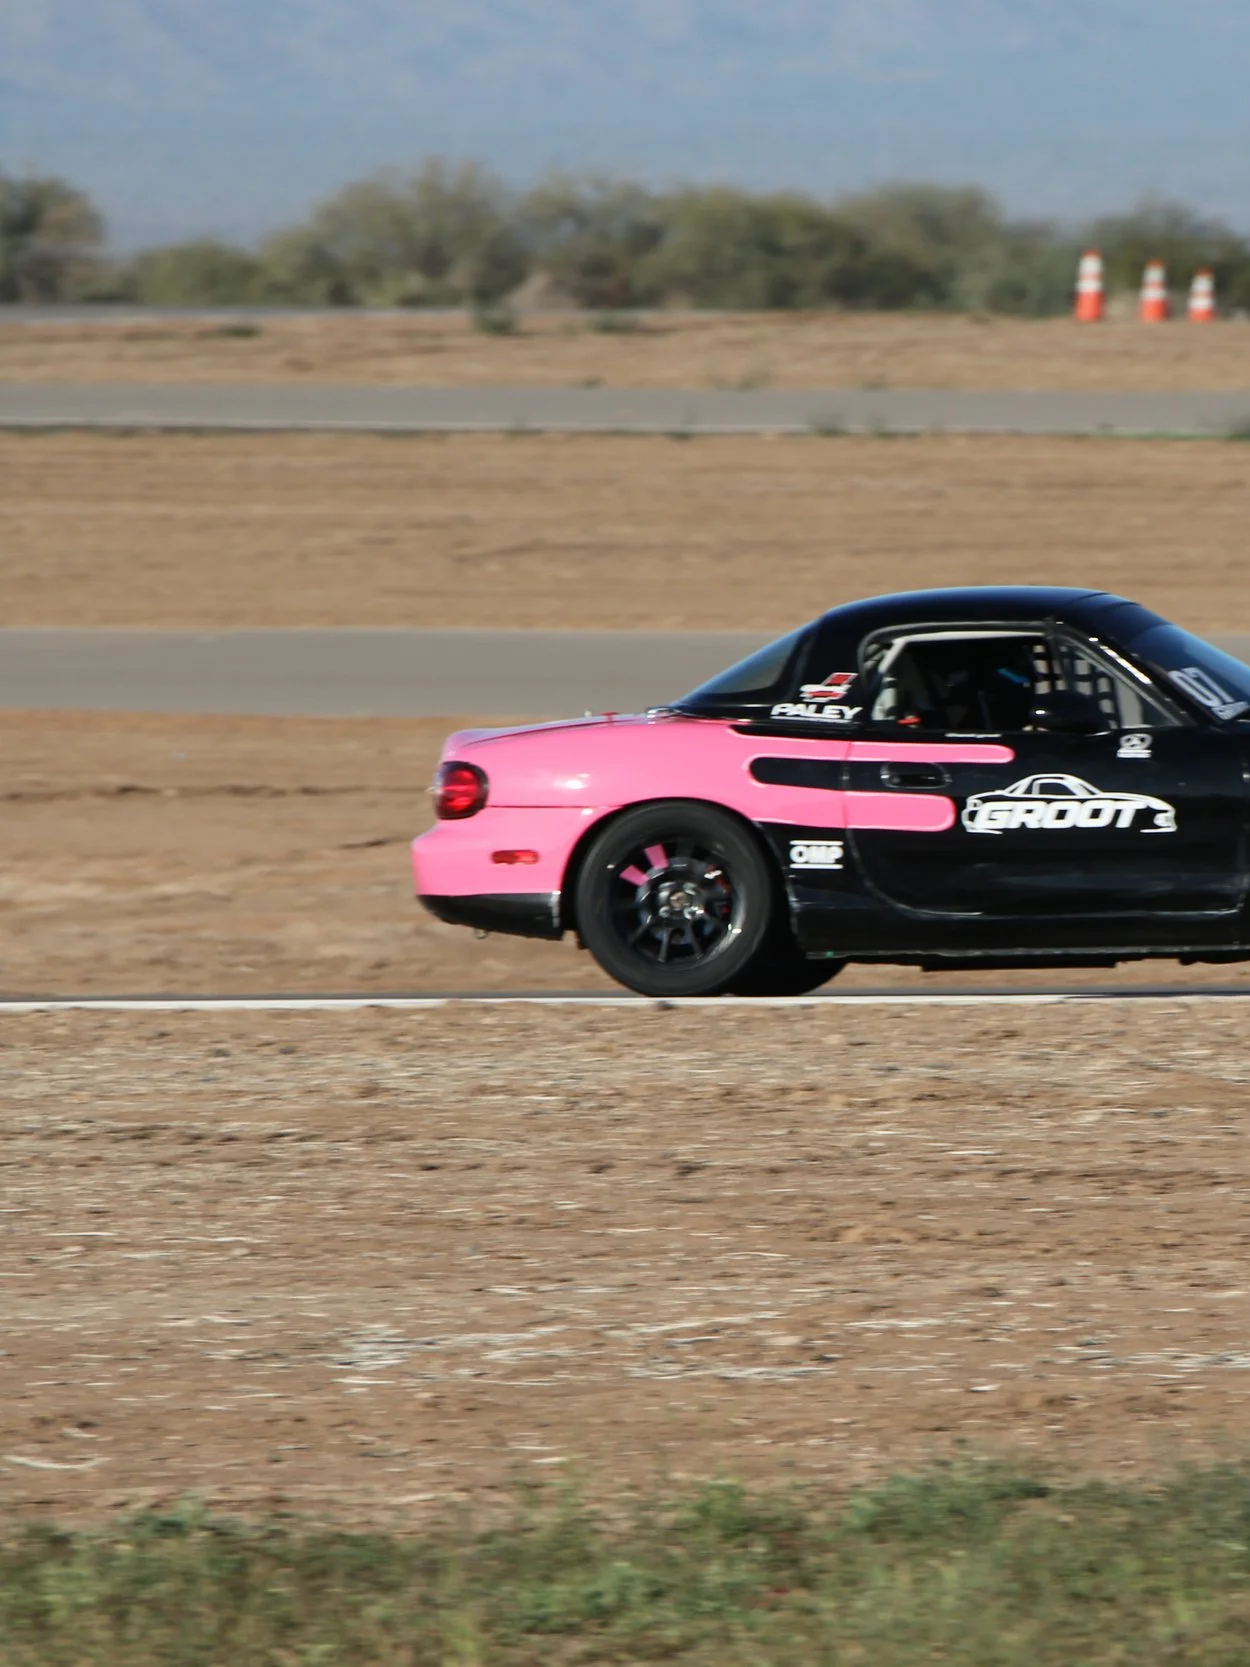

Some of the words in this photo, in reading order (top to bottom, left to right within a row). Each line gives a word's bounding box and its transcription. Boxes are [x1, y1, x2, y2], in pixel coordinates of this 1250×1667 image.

[1168, 667, 1234, 707] 07
[770, 703, 863, 720] PALEY
[974, 800, 1147, 828] GROOT
